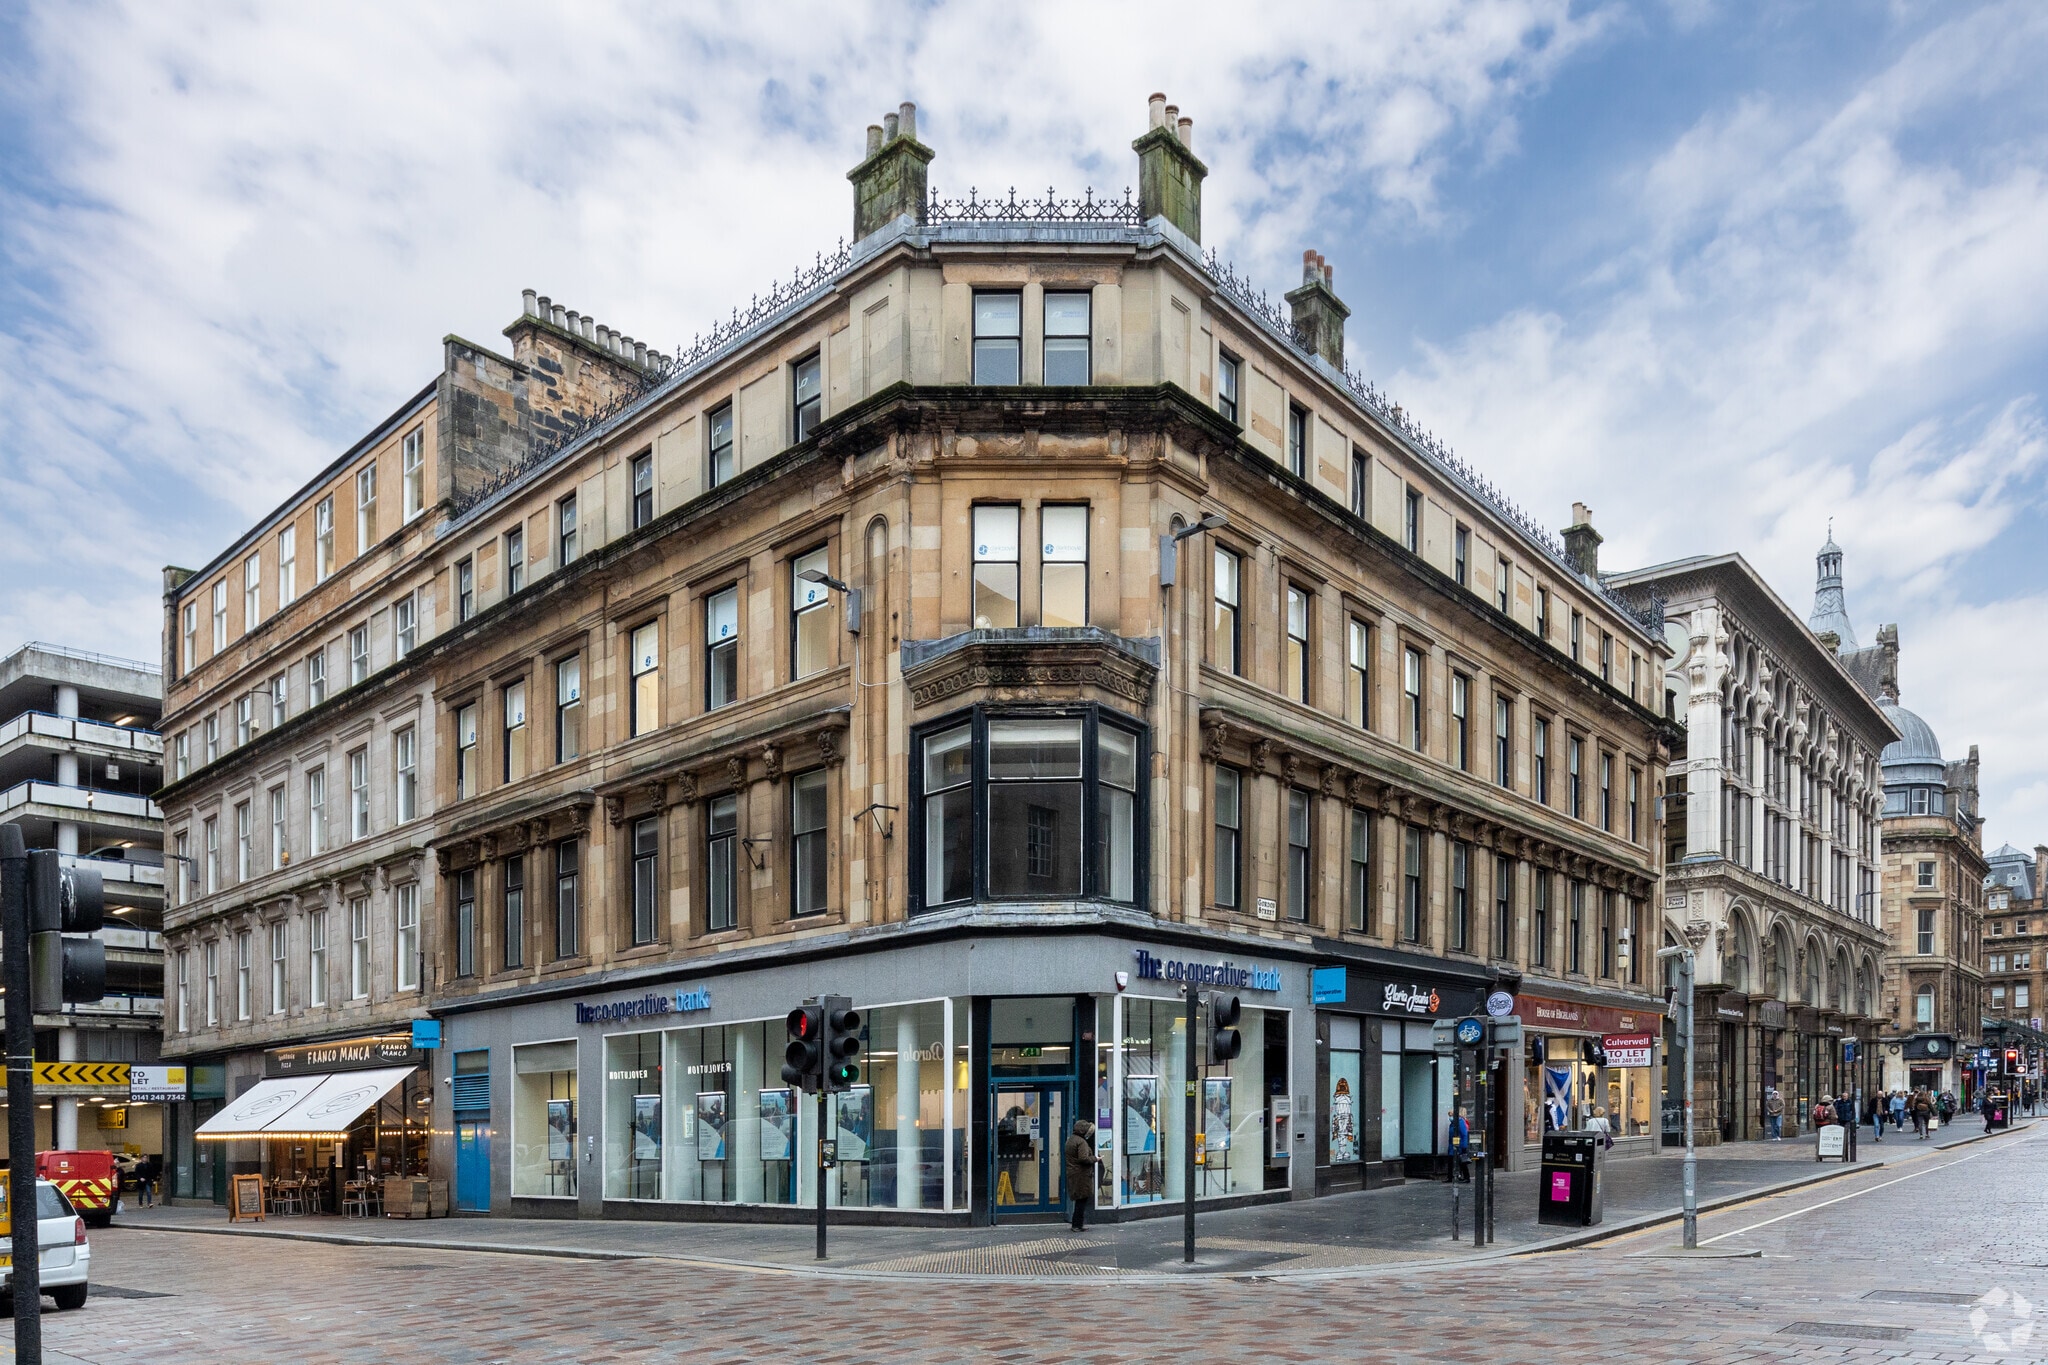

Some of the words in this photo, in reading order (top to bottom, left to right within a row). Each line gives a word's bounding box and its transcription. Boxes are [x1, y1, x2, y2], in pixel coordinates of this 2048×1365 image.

[1136, 949, 1162, 979] The
[1251, 963, 1282, 991] bank
[574, 1002, 594, 1024] The
[675, 985, 711, 1012] bank
[1383, 984, 1408, 1010] Gloria
[1605, 1037, 1649, 1046] Culverwell
[308, 1050, 336, 1064] FRANCO
[340, 1045, 370, 1062] MANCA
[1627, 1049, 1645, 1057] LET
